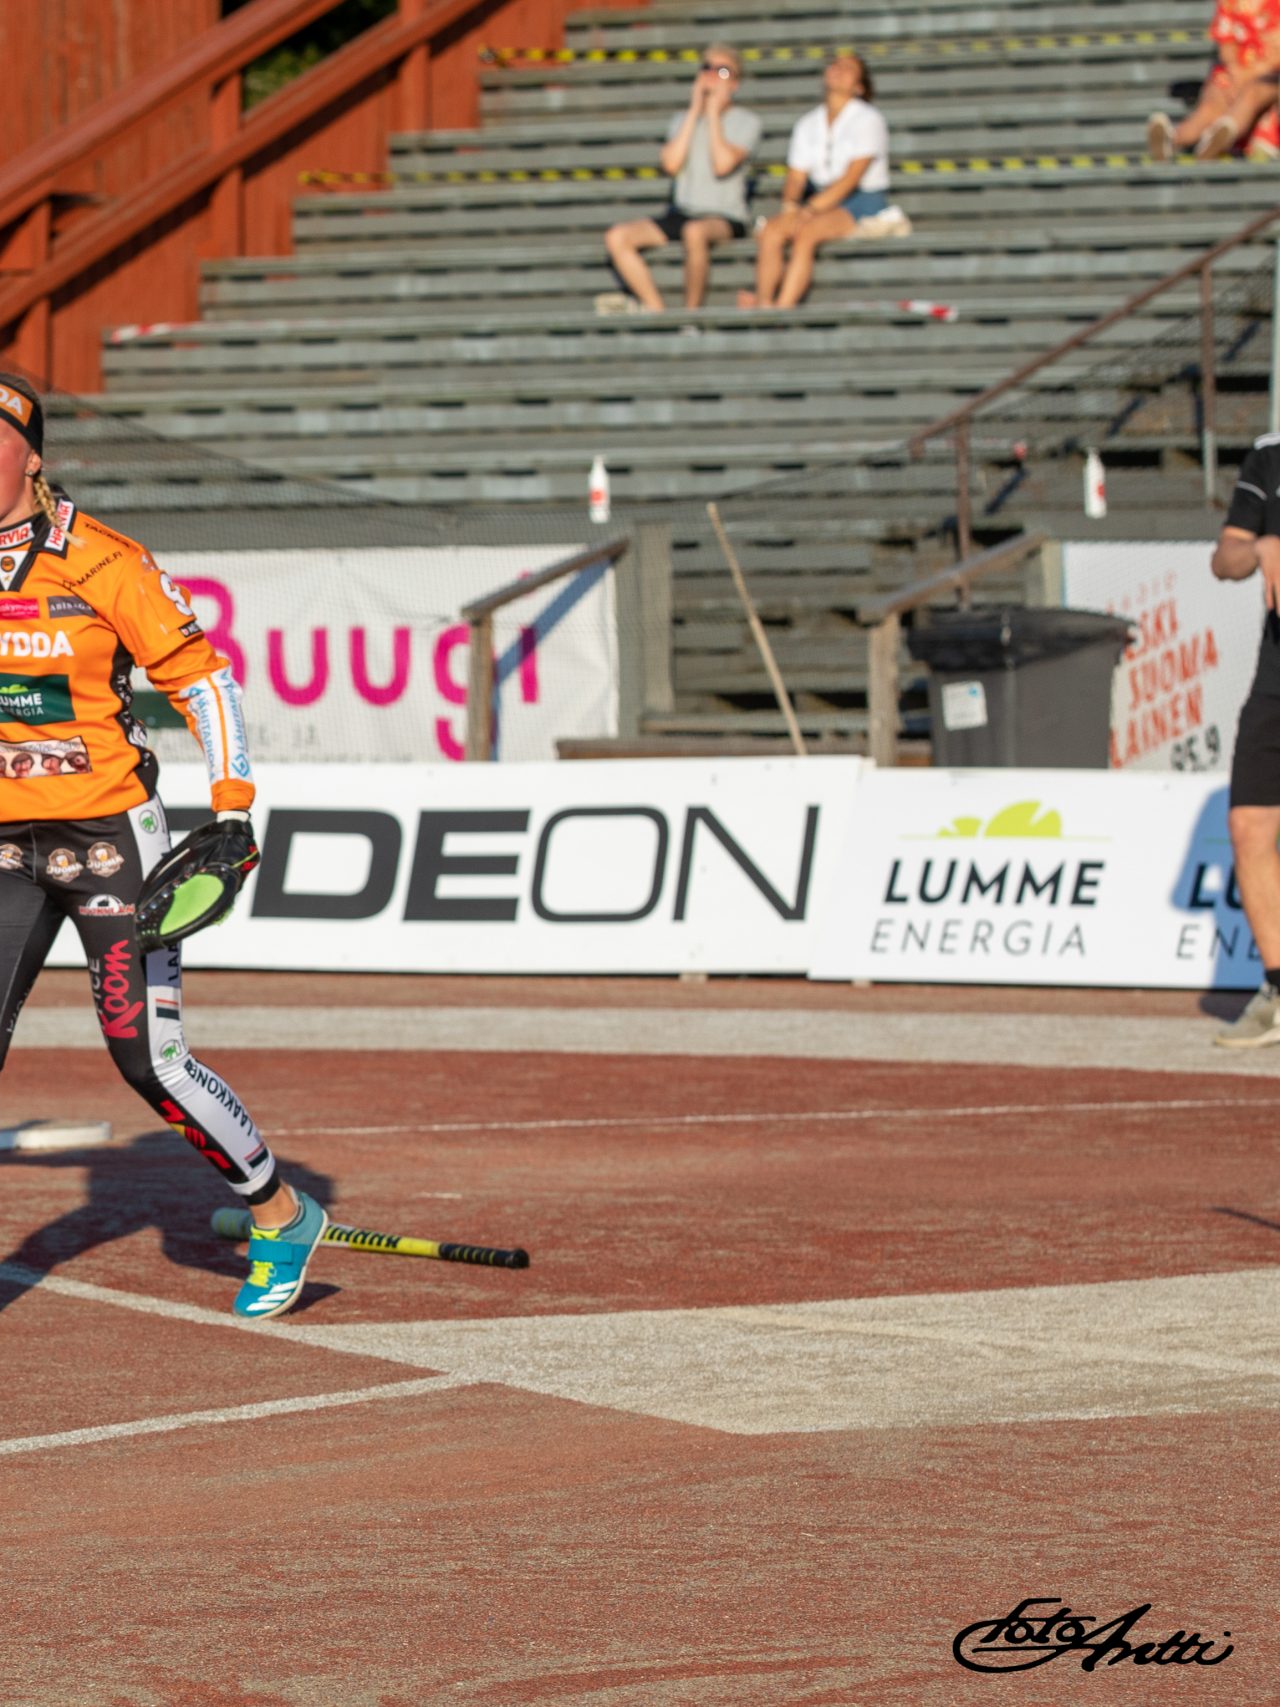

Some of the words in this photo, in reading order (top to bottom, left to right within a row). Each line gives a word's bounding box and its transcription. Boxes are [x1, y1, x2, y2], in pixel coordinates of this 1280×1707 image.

[164, 804, 822, 923] DEON
[883, 858, 1106, 907] LUMME
[869, 917, 1087, 957] ENERGIA
